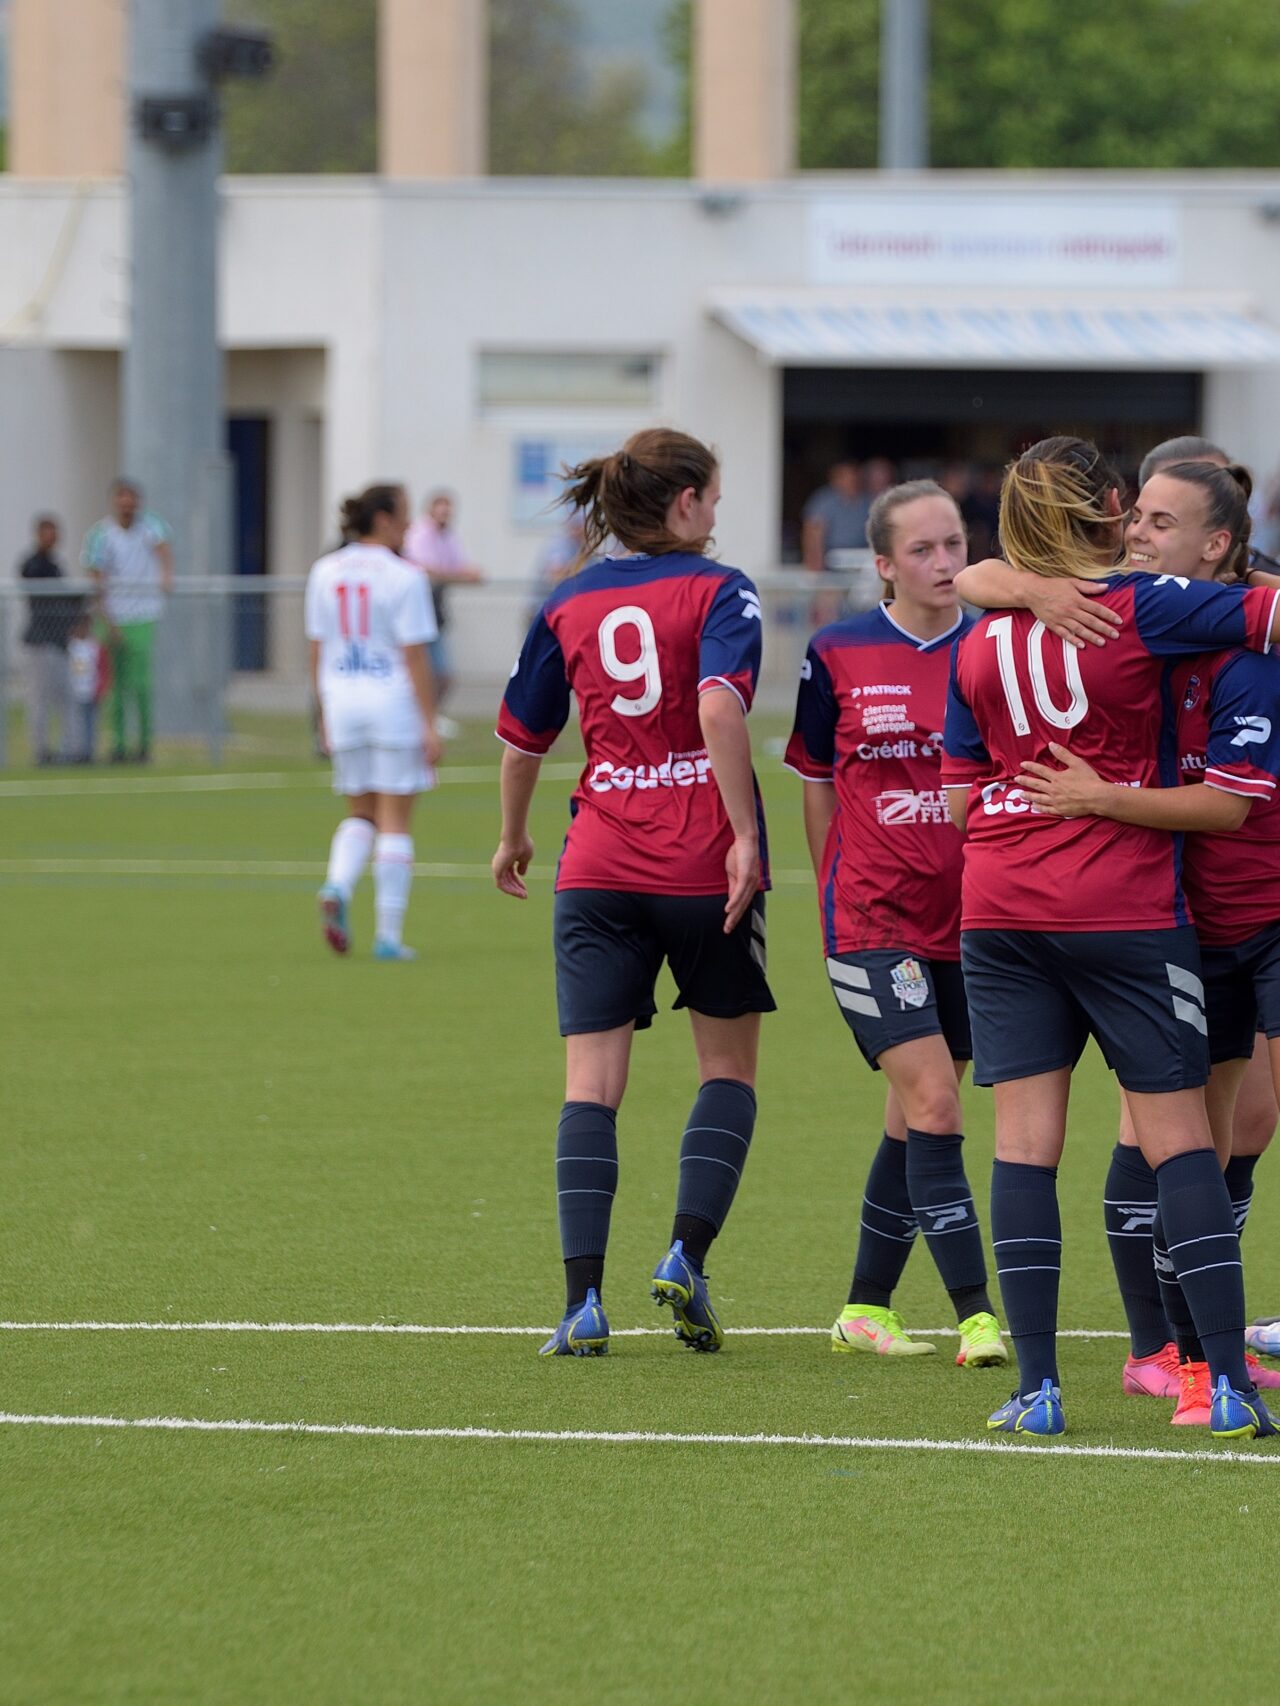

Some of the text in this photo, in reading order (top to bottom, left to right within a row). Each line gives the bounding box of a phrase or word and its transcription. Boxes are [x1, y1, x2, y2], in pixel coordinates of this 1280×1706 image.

[335, 583, 371, 640] 11
[598, 605, 662, 717] 9
[986, 615, 1089, 737] 10
[863, 685, 912, 697] PATRICK
[588, 751, 712, 792] Couder
[856, 740, 917, 760] Crédit
